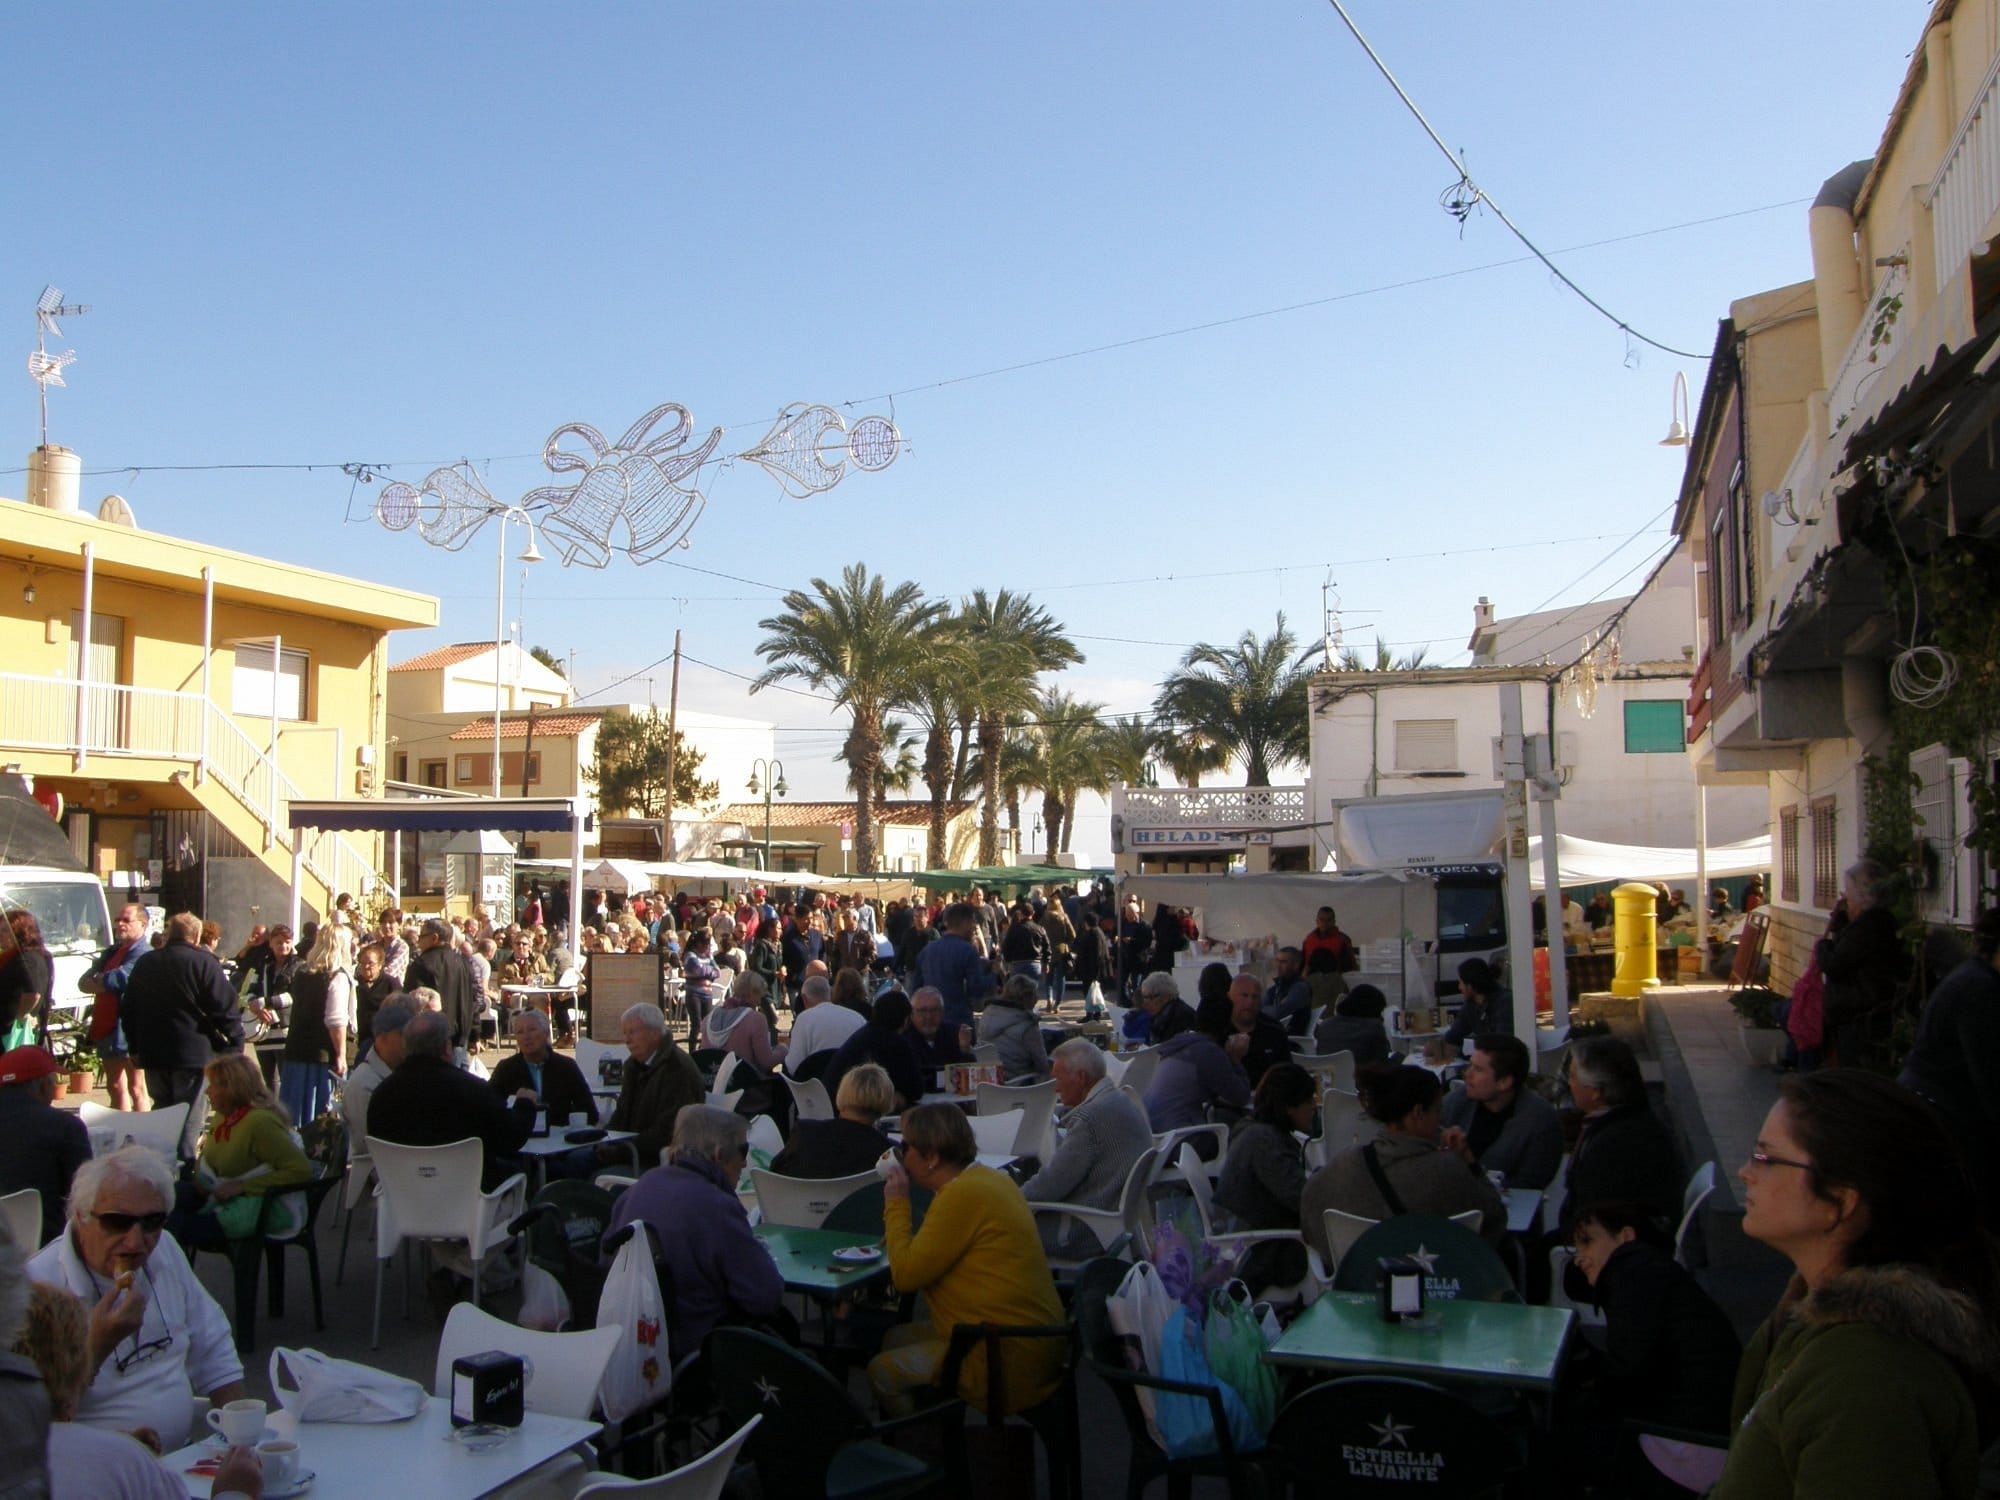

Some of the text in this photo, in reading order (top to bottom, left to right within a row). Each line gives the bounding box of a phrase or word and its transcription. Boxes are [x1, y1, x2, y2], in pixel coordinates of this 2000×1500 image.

[1424, 1277, 1461, 1291] ELLA
[1342, 1444, 1445, 1467] ESTRELLA
[1349, 1460, 1439, 1482] LEVANTE
